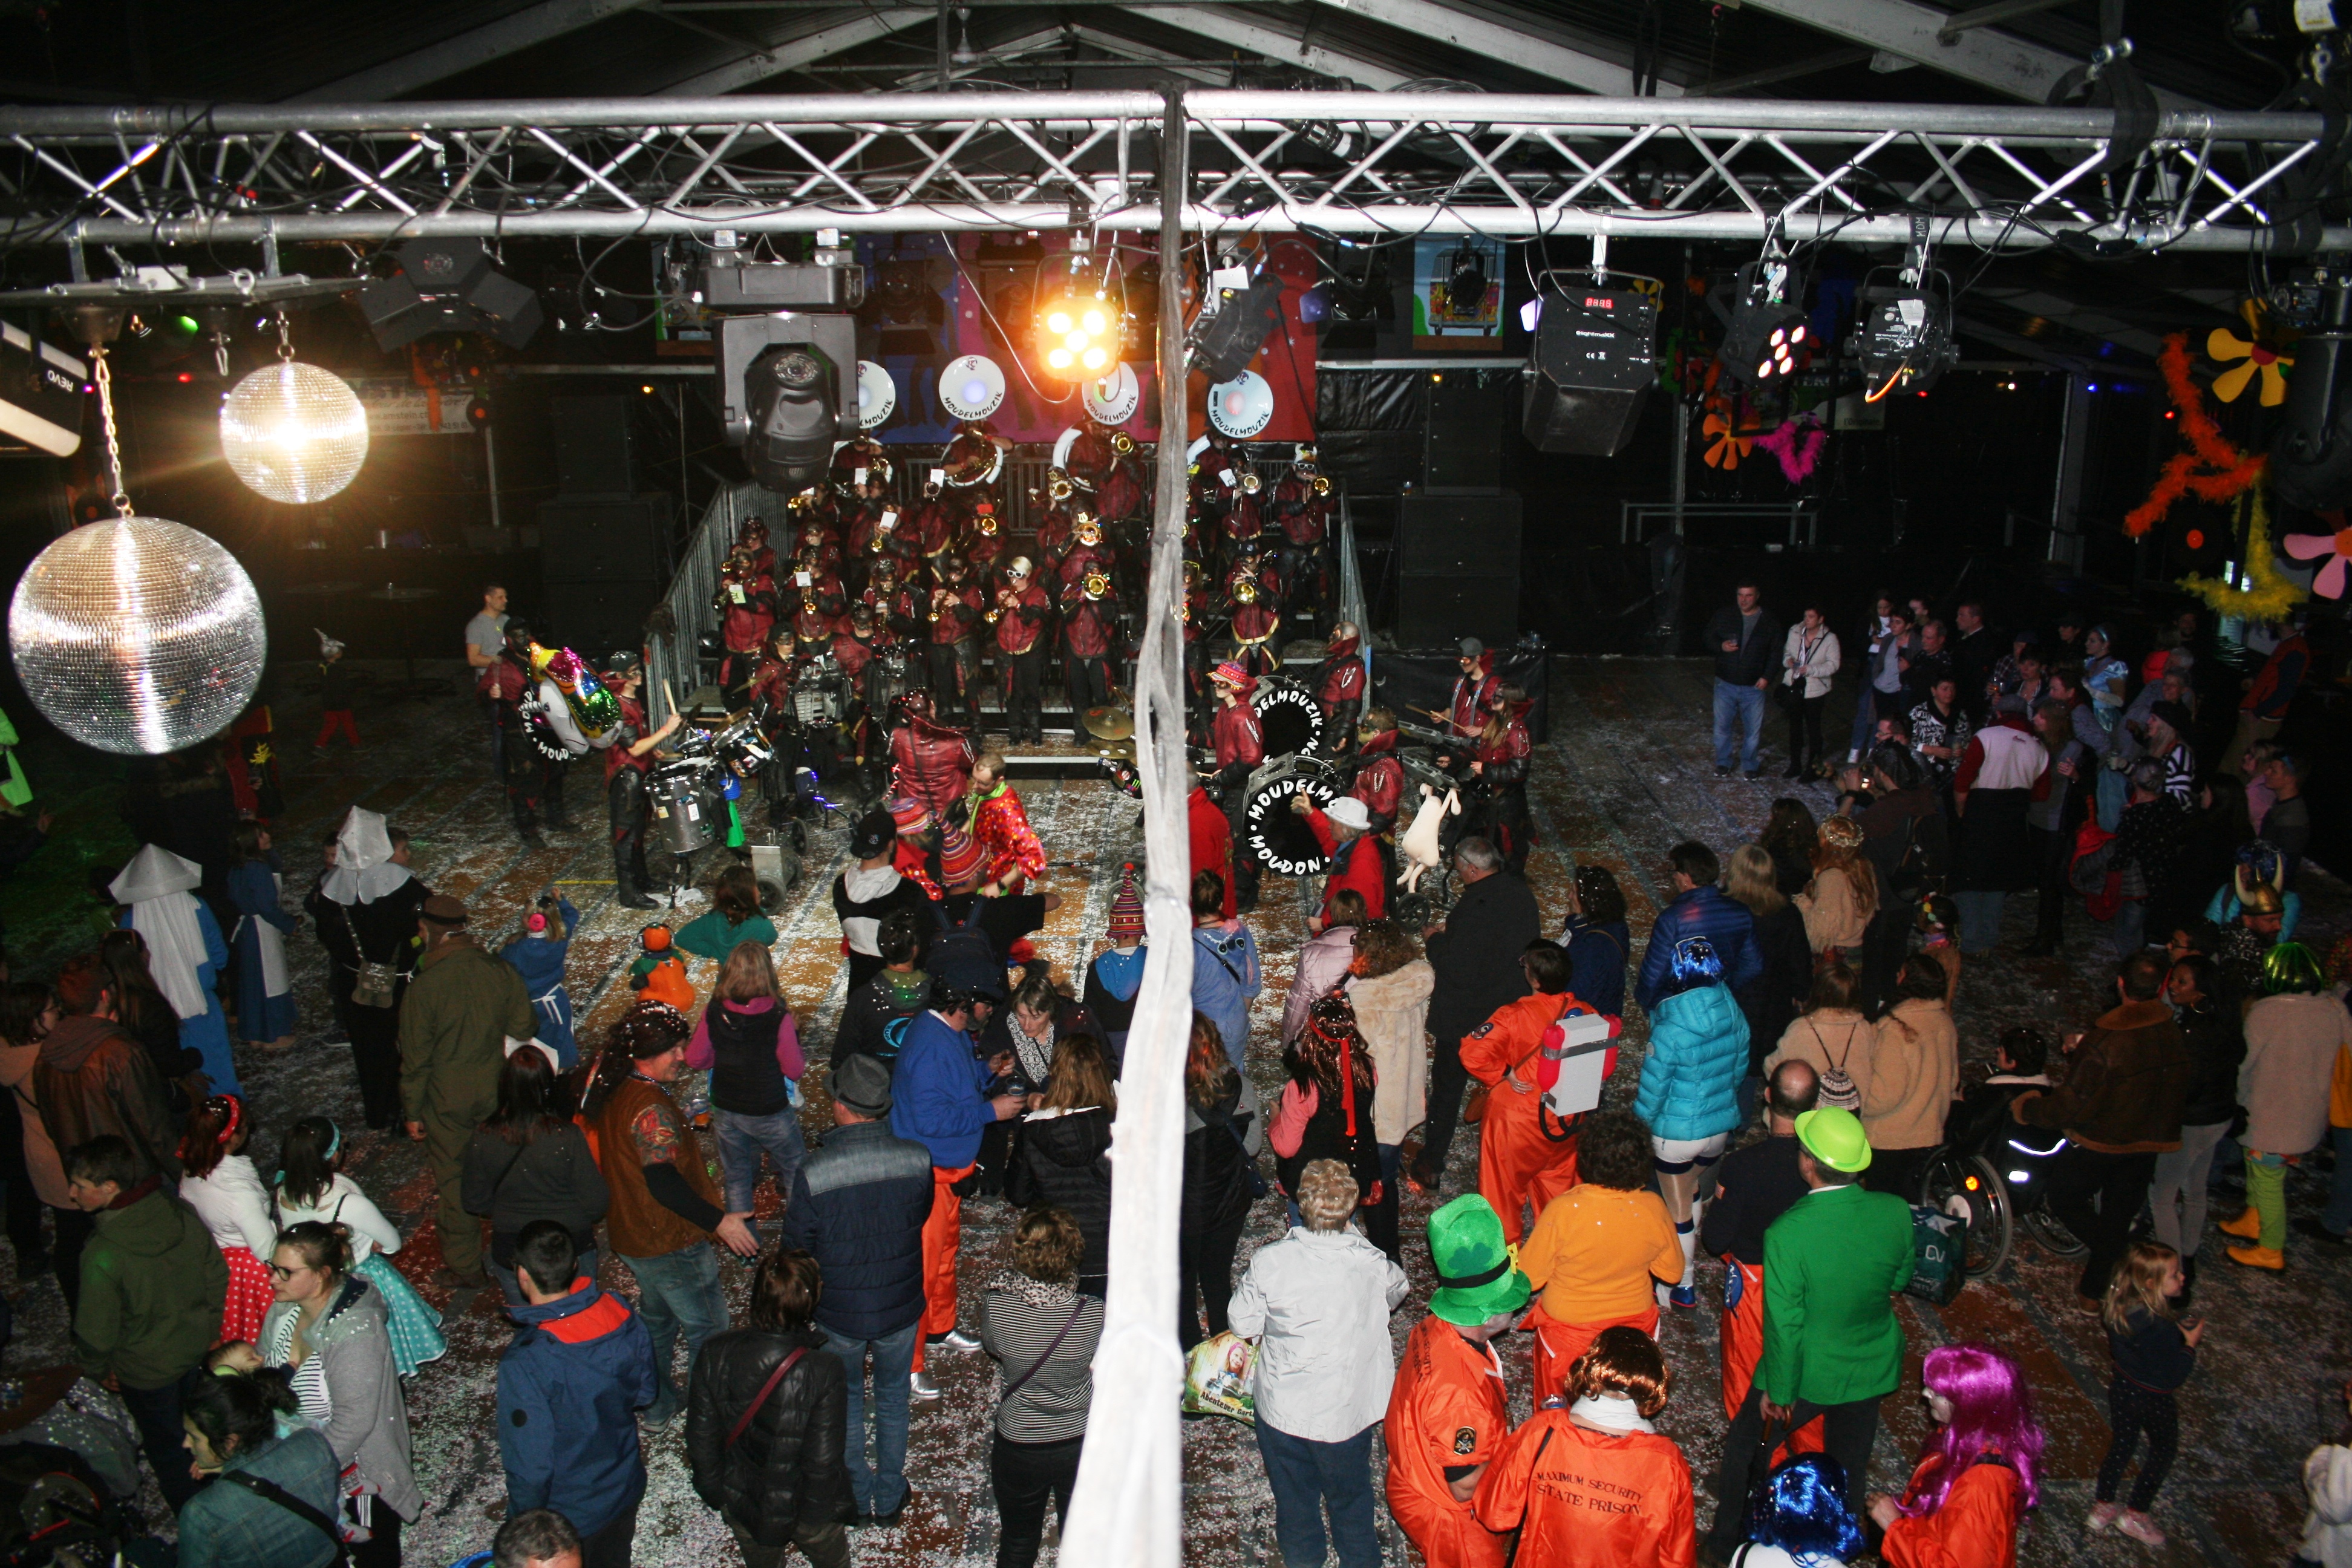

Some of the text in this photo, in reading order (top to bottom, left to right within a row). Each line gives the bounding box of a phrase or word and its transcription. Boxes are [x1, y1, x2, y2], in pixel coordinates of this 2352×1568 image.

[47, 369, 74, 392] REVO
[859, 398, 893, 426] LMOUZIK
[942, 392, 1002, 419] MOUDELMOUZIK
[1086, 394, 1137, 423] MOUDELMOUZIK
[1210, 410, 1270, 436] MOUDELMOUZIK
[1253, 690, 1323, 728] DELMOUZIK
[1248, 779, 1336, 820] MOUDELMO
[1248, 835, 1321, 875] MOUDON
[1200, 1390, 1235, 1413] Abenteuer
[1536, 1471, 1643, 1504] MAXIMUM SECURITY
[1536, 1482, 1642, 1516] STATE PRISON
